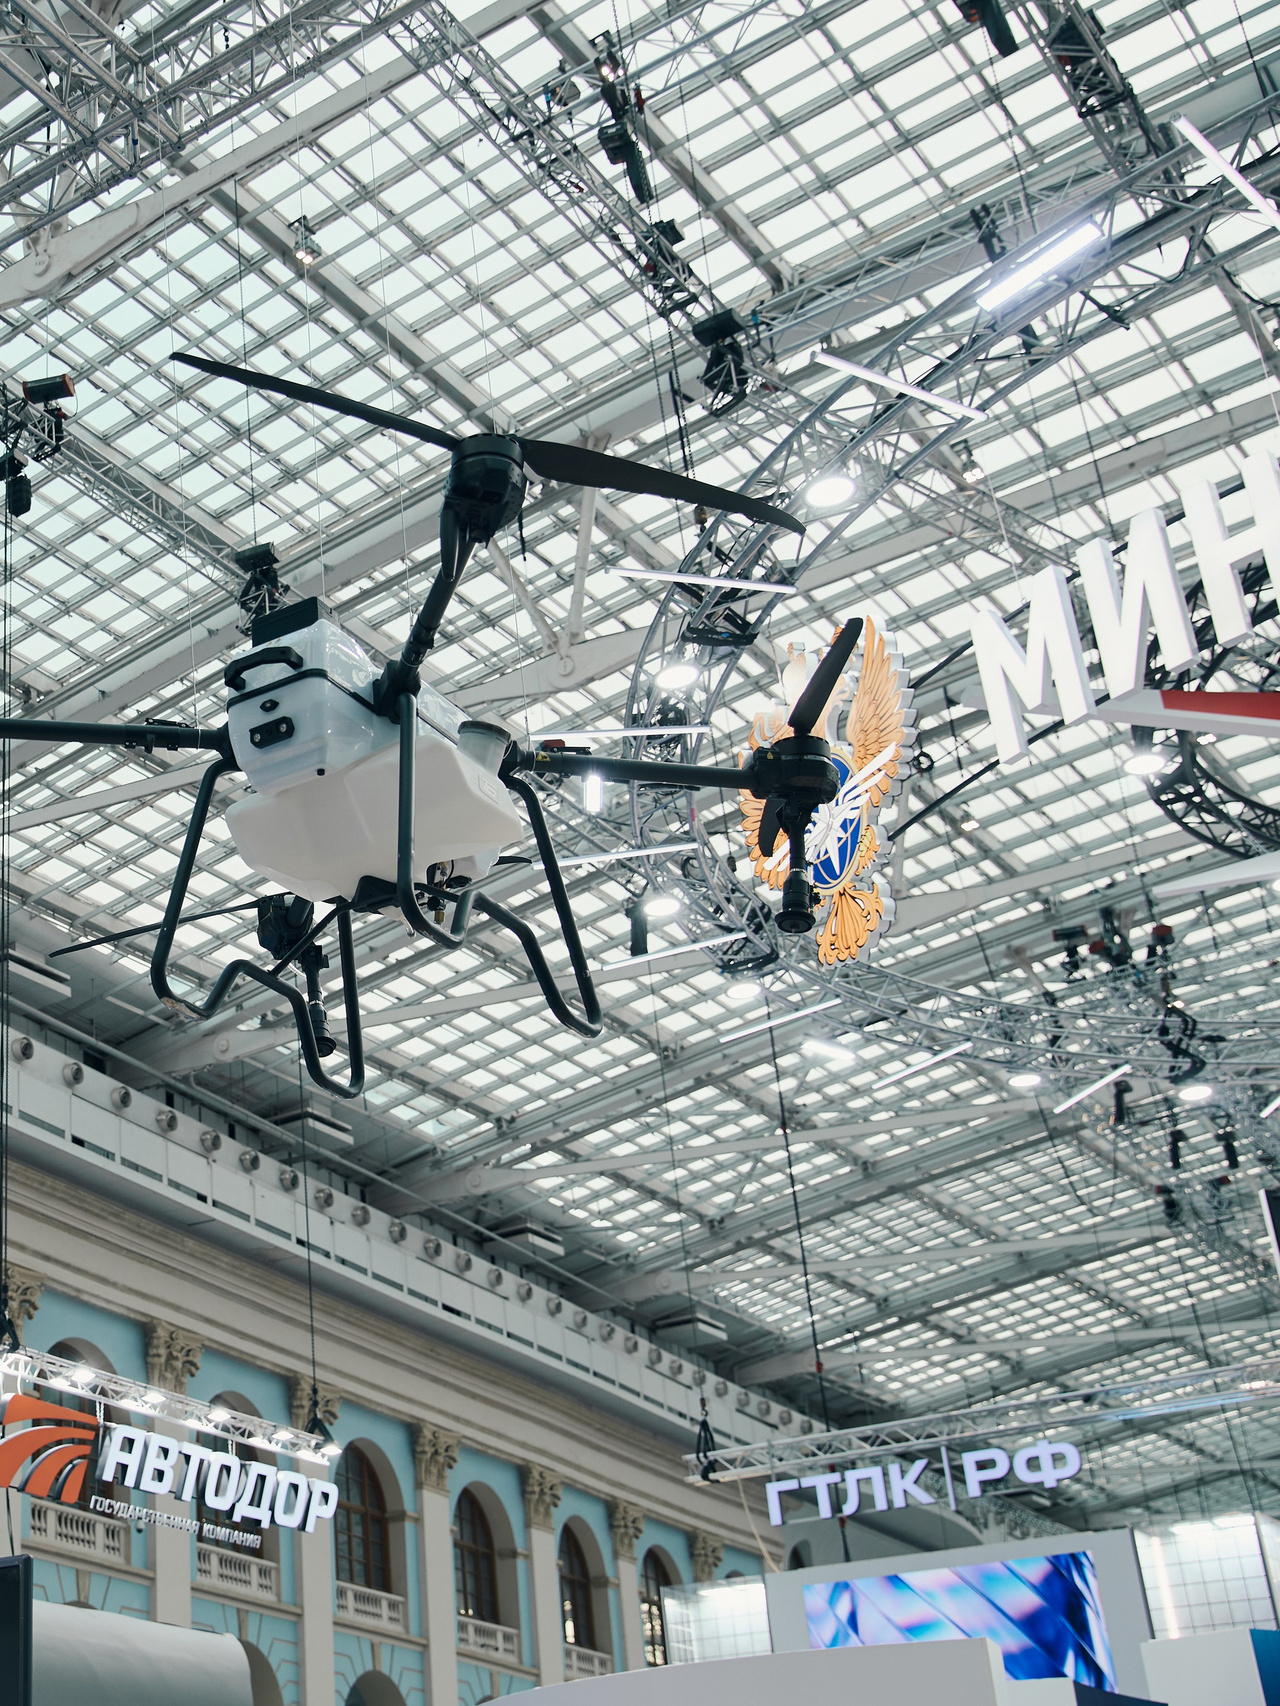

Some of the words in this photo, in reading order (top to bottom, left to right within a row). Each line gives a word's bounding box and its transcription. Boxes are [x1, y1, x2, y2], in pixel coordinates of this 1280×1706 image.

[970, 450, 1280, 765] МИН
[89, 1495, 201, 1535] ГОСУДАРСТВЕННАЯ
[202, 1523, 262, 1549] КОМПАНИЯ
[99, 1424, 339, 1533] АВТОДОР
[765, 1458, 936, 1526] ГТЛК
[961, 1439, 1082, 1498] РФ
